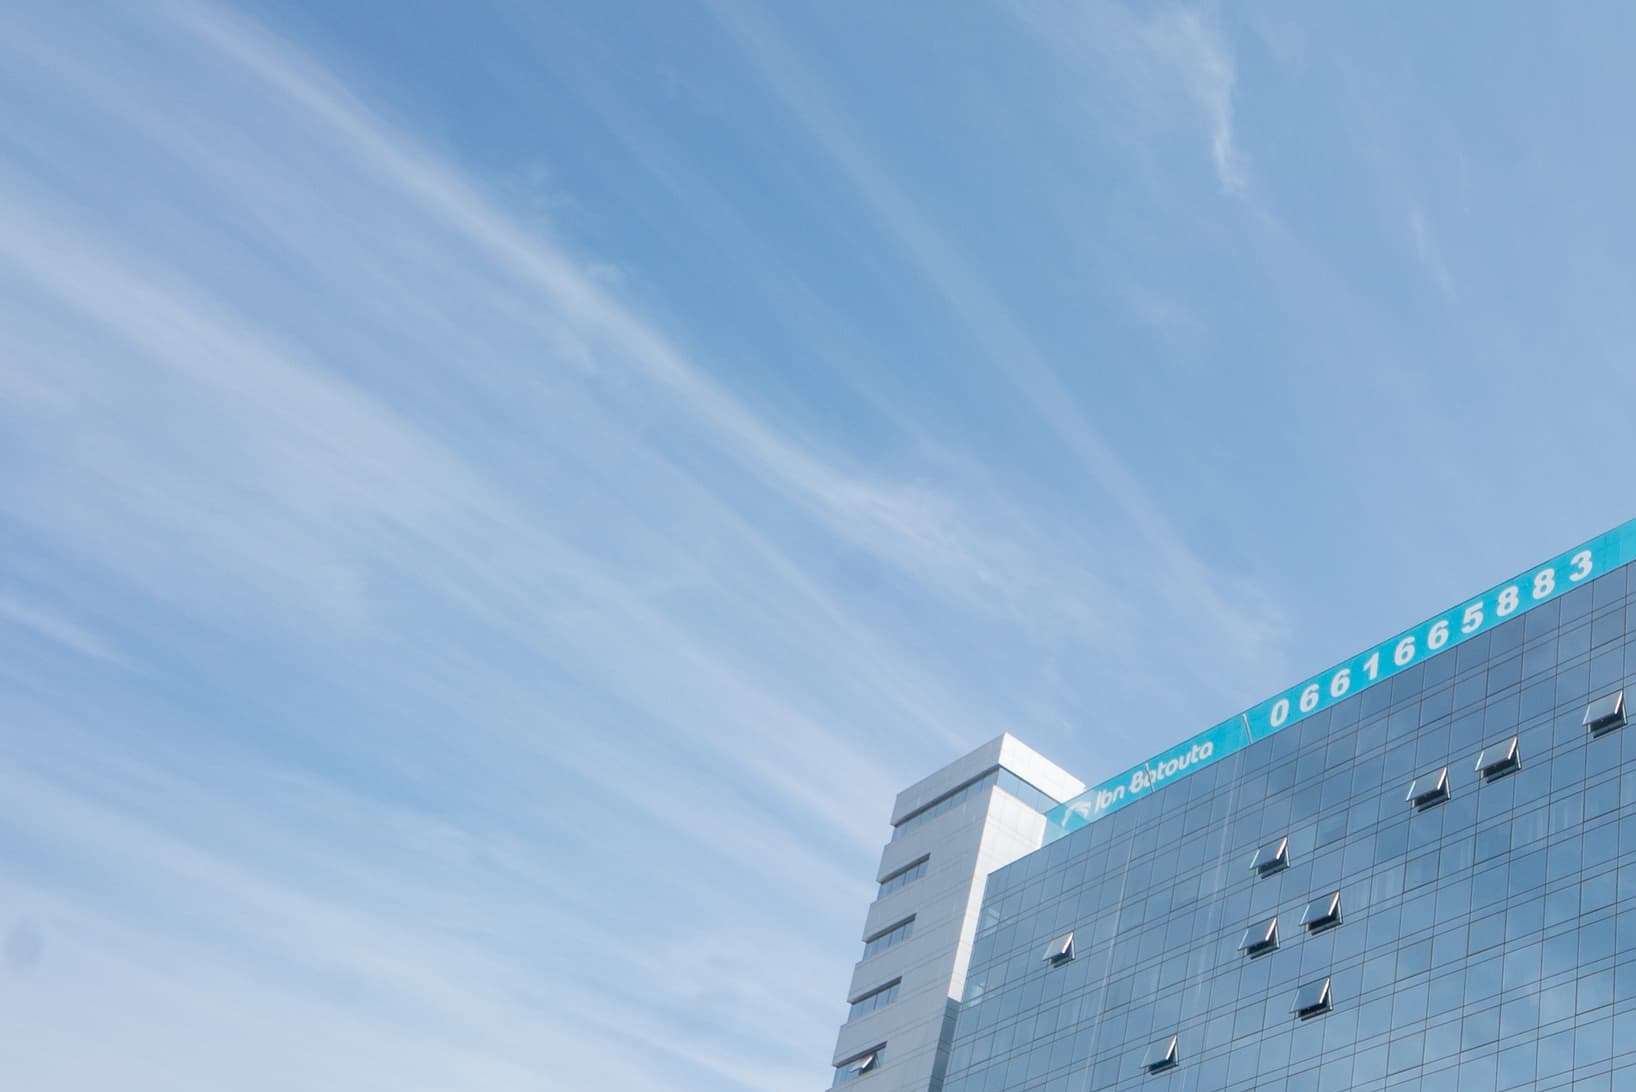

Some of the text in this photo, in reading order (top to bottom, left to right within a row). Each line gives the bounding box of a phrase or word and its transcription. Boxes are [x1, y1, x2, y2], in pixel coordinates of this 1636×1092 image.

[1269, 549, 1593, 728] 0661665883
[1094, 741, 1214, 815] Ibn Batouta
